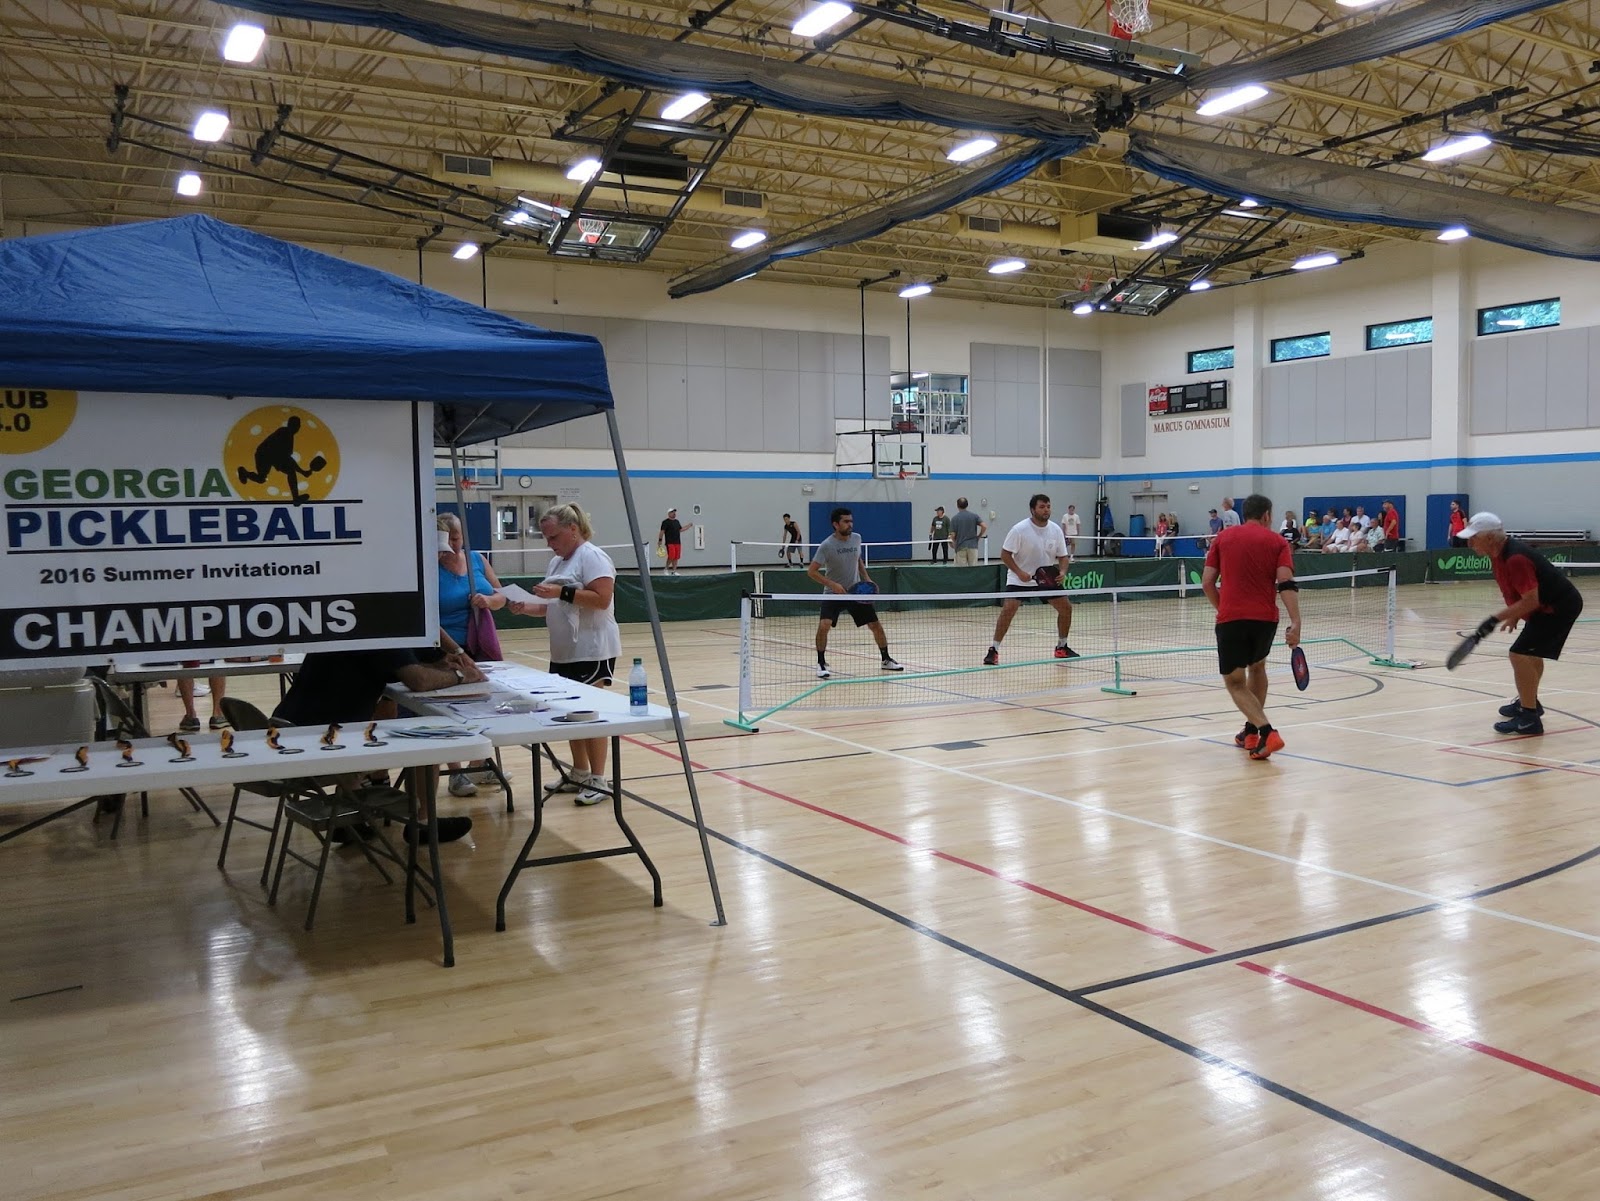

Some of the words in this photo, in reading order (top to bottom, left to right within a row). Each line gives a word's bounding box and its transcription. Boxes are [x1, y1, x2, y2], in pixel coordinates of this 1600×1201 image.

[0, 390, 48, 409] UB
[1153, 421, 1183, 433] MARCUS
[1185, 417, 1230, 431] GYMNASIUM
[3, 468, 232, 500] GEORGIA
[7, 506, 362, 548] PICKLEBALL
[40, 567, 96, 584] 2016
[103, 565, 195, 583] Summer
[202, 561, 321, 579] Invitational
[1063, 571, 1104, 590] tterfly
[13, 599, 357, 651] CHAMPIONS
